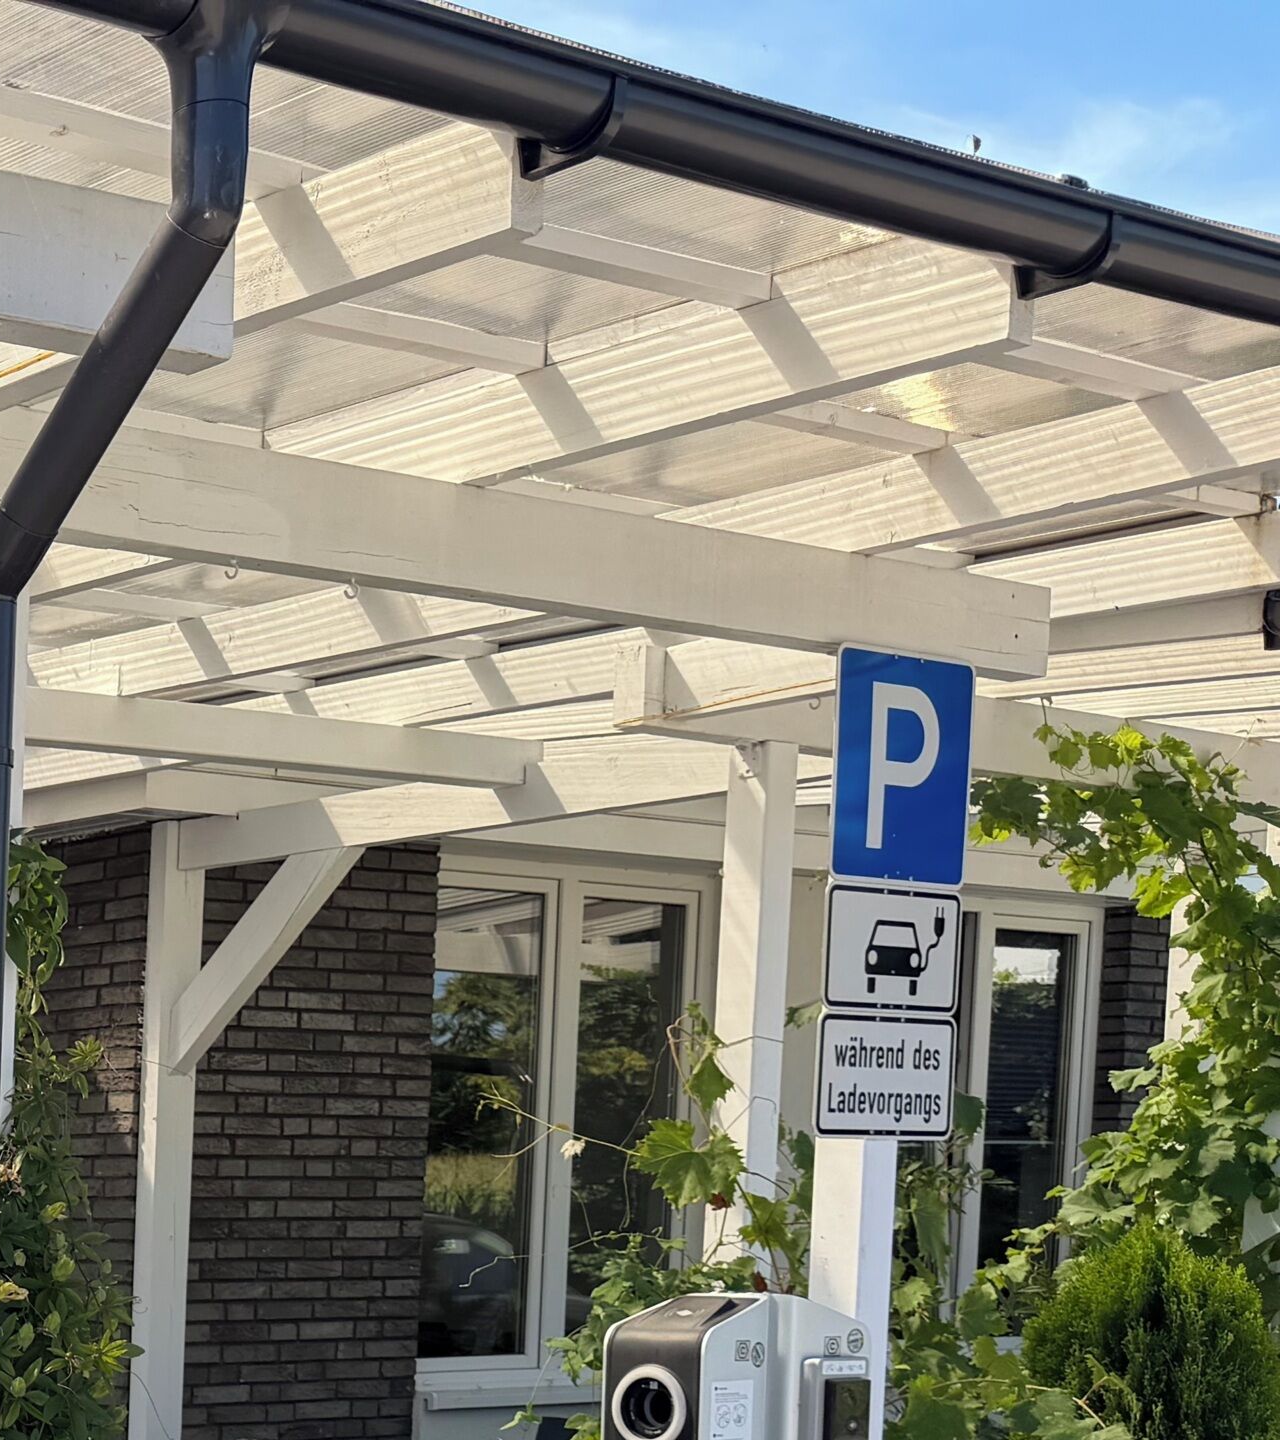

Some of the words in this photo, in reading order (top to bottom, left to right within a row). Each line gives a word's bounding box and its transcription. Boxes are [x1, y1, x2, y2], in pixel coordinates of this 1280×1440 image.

[865, 681, 940, 849] P
[834, 1036, 905, 1069] während
[913, 1039, 941, 1071] des
[827, 1082, 942, 1124] Ladevorgangs
